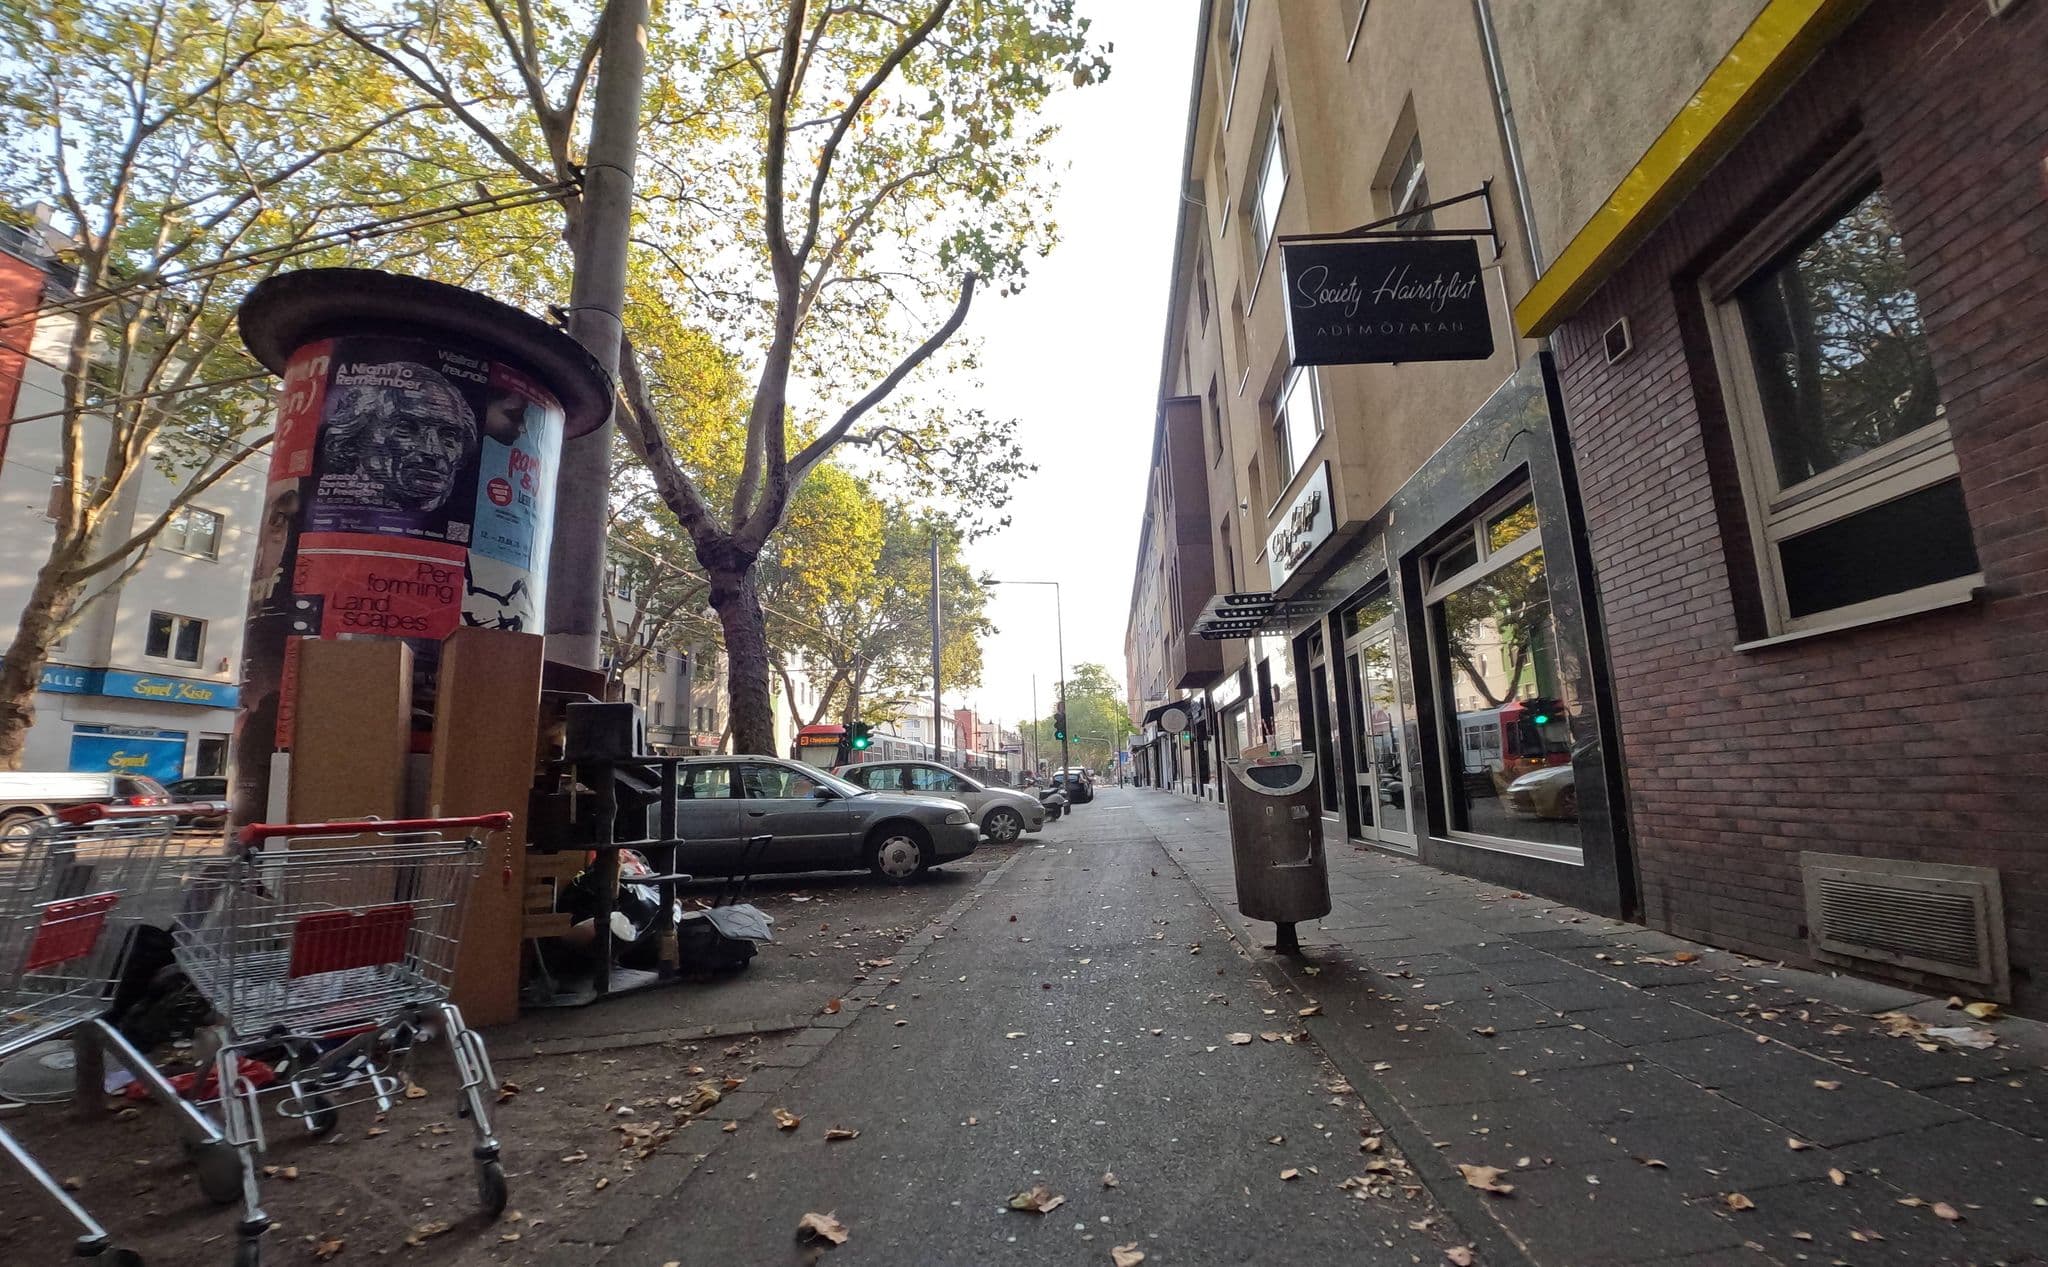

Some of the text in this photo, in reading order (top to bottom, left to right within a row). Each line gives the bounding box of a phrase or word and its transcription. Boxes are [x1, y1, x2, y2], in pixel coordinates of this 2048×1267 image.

[1295, 263, 1478, 318] Society Hairstylist
[337, 363, 348, 374] A
[351, 363, 393, 377] Night
[335, 374, 423, 391] Remember
[417, 563, 457, 584] Per
[367, 572, 454, 604] forming
[332, 592, 390, 612] Land
[343, 611, 430, 632] scapes
[41, 672, 85, 688] ALLE
